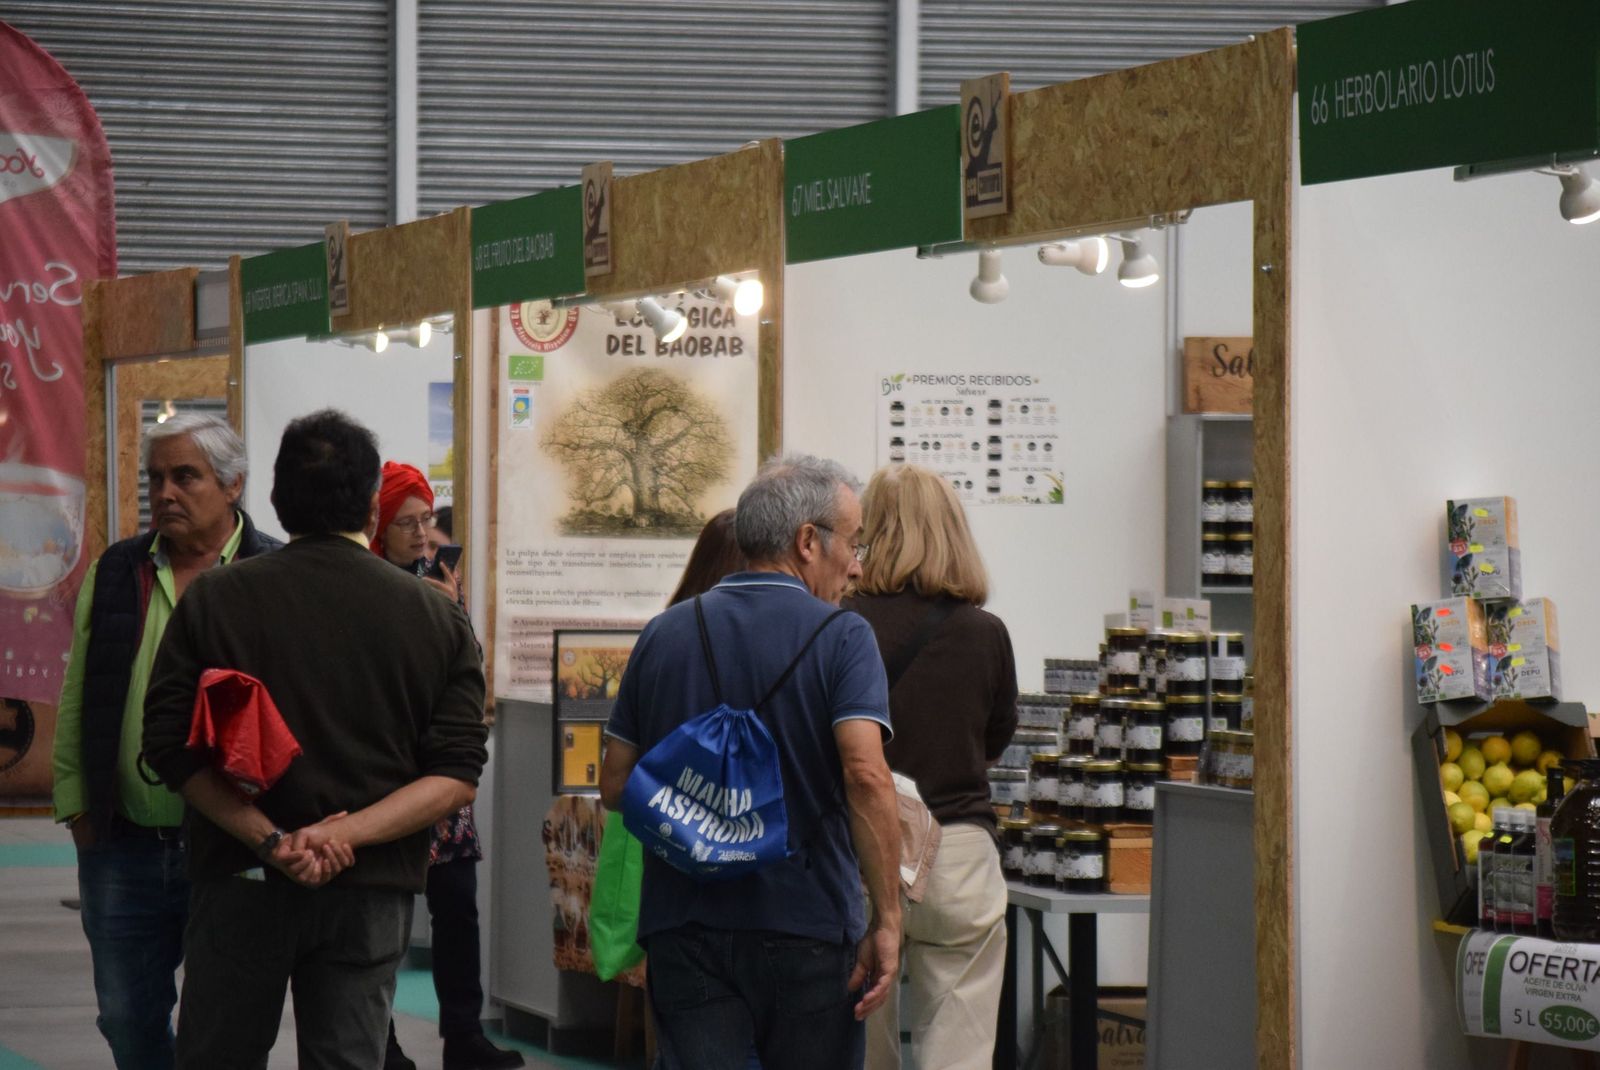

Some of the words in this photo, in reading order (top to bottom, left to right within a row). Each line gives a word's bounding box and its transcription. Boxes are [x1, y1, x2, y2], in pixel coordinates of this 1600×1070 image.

[1311, 84, 1329, 126] 66
[1335, 60, 1438, 120] HERBOLARIO
[1443, 48, 1496, 100] LOTUS
[792, 184, 803, 217] 67
[804, 180, 826, 214] MIEL
[827, 172, 872, 210] SALVAXE
[606, 334, 646, 357] DEL
[656, 335, 744, 358] BAOBAB
[912, 375, 966, 385] PREMIOS
[969, 375, 1032, 386] RECIBIDOS
[1464, 952, 1487, 975] OFE
[1524, 978, 1551, 987] ACEITE
[1553, 981, 1563, 989] DE
[1565, 983, 1587, 992] OLIVA
[1525, 988, 1554, 998] VIRGEN
[1556, 992, 1581, 1002] EXTRA
[1514, 1009, 1521, 1024] 5
[1527, 1010, 1535, 1026] L
